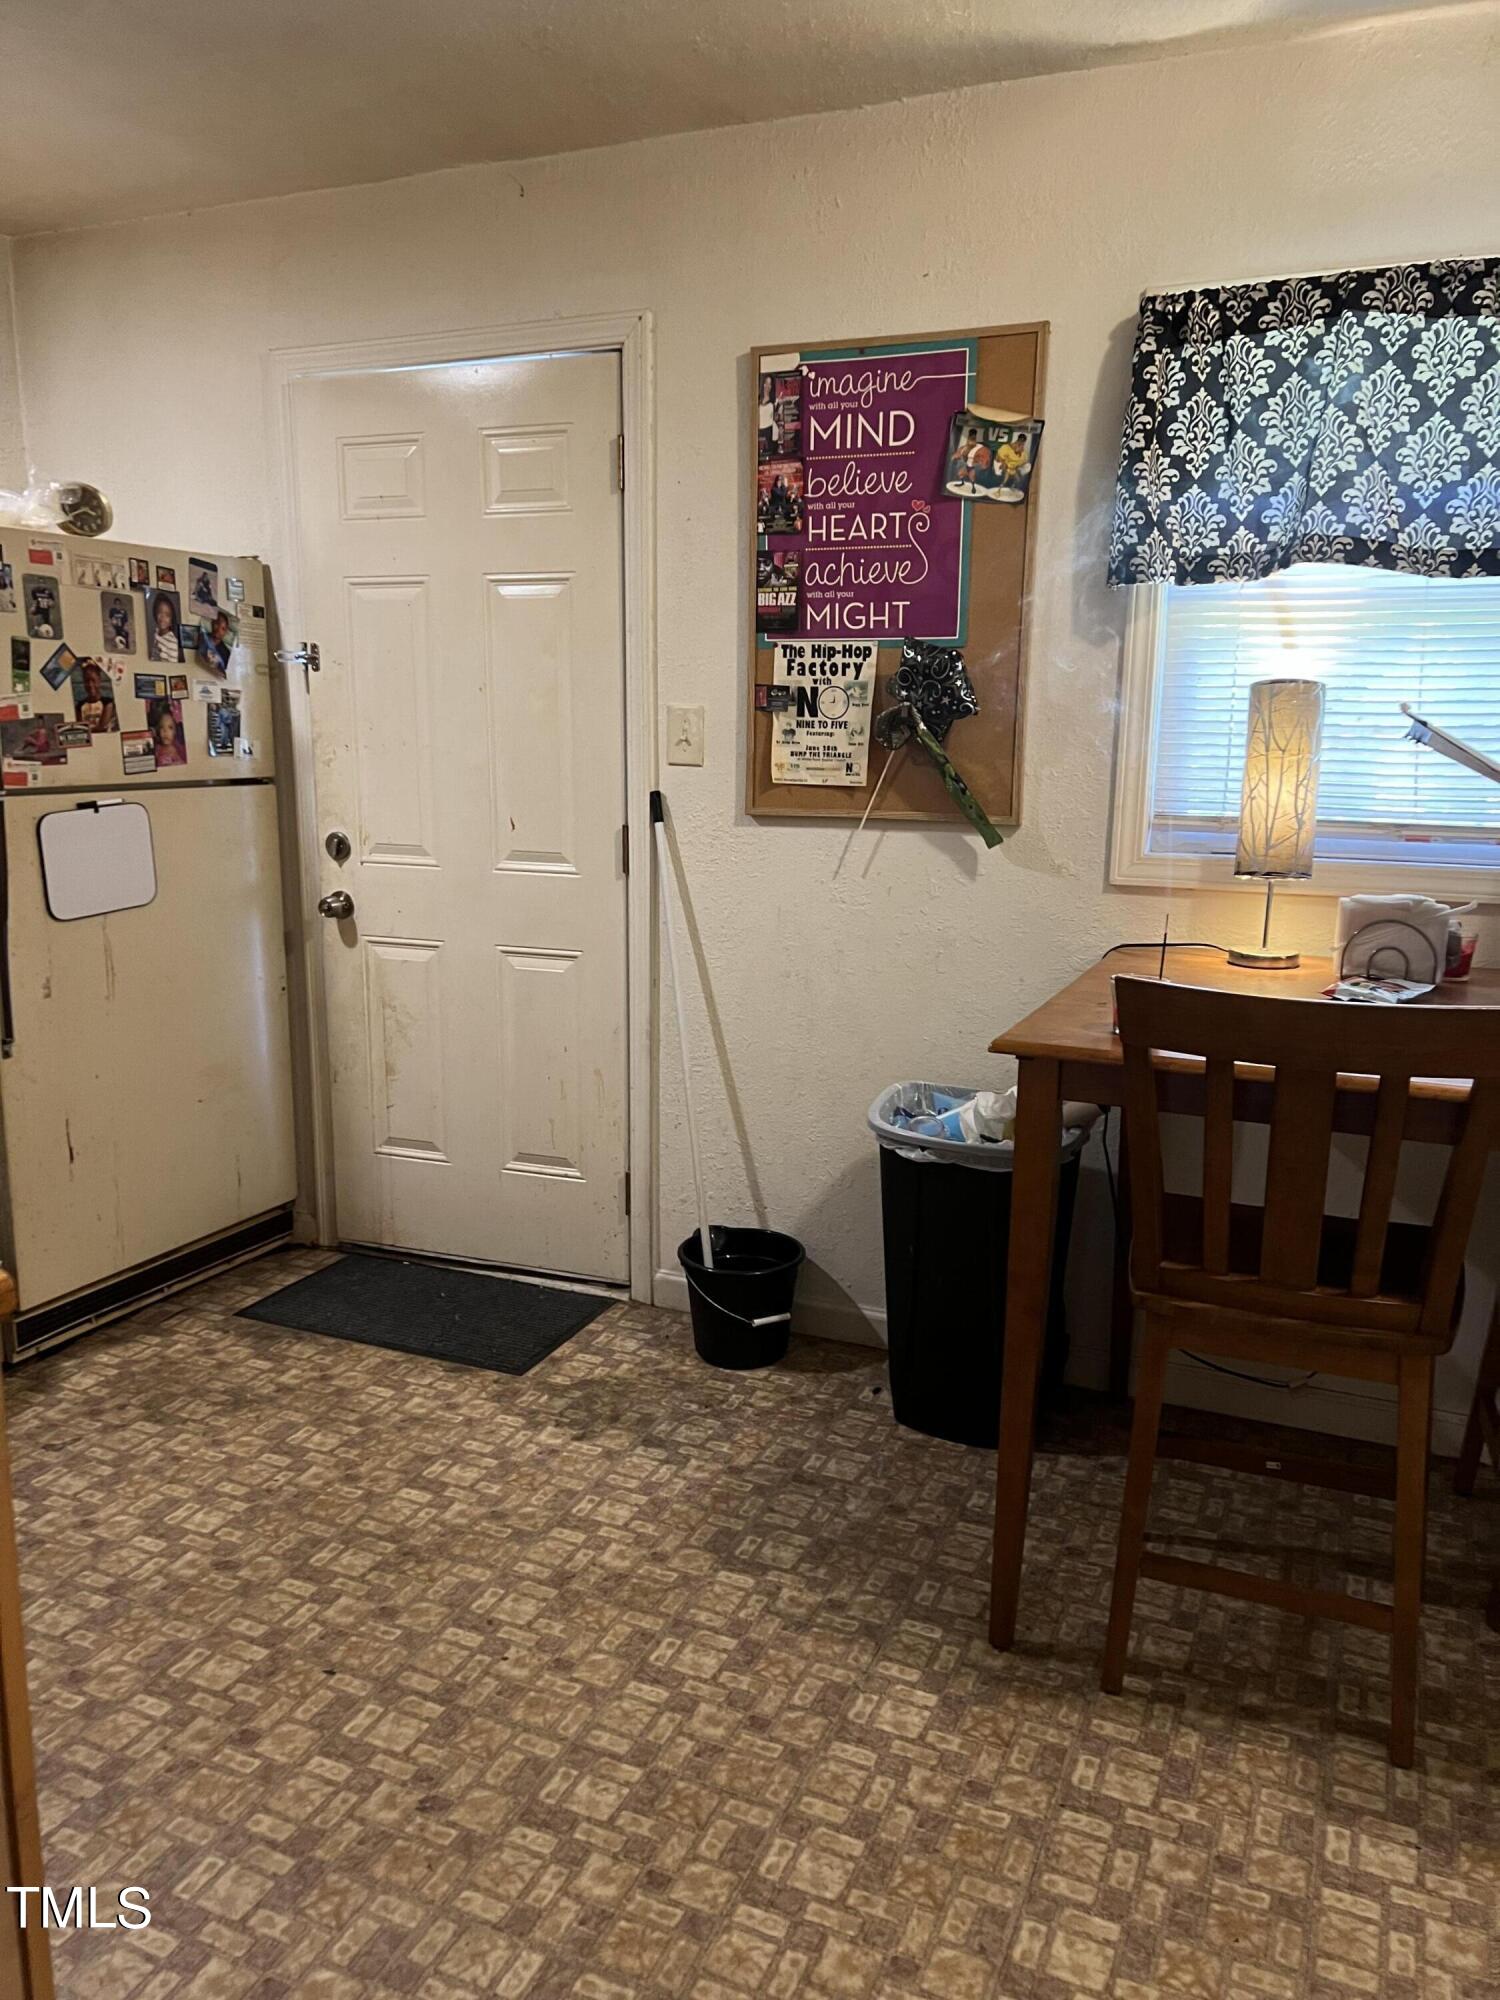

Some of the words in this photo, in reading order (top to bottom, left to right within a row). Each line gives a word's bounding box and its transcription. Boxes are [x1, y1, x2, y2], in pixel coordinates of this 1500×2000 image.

[809, 370, 917, 408] imagine
[809, 402, 826, 410] with
[827, 401, 839, 409] all
[840, 401, 859, 409] your
[809, 410, 915, 451] MIND
[988, 427, 1010, 442] VS
[804, 461, 912, 498] believe
[807, 502, 824, 510] with
[838, 502, 855, 510] your
[808, 512, 907, 542] HEART
[805, 552, 928, 586] achieve
[757, 592, 777, 606] BIG
[777, 592, 797, 606] AZZ
[824, 590, 835, 598] all
[836, 591, 854, 599] your
[806, 601, 911, 630] MIGHT
[781, 644, 805, 659] The
[811, 644, 872, 661] Hip-Hop
[786, 658, 863, 680] Factory
[812, 677, 832, 685] with
[796, 720, 815, 729] NINE
[818, 721, 828, 729] TO
[830, 721, 848, 729] FIVE
